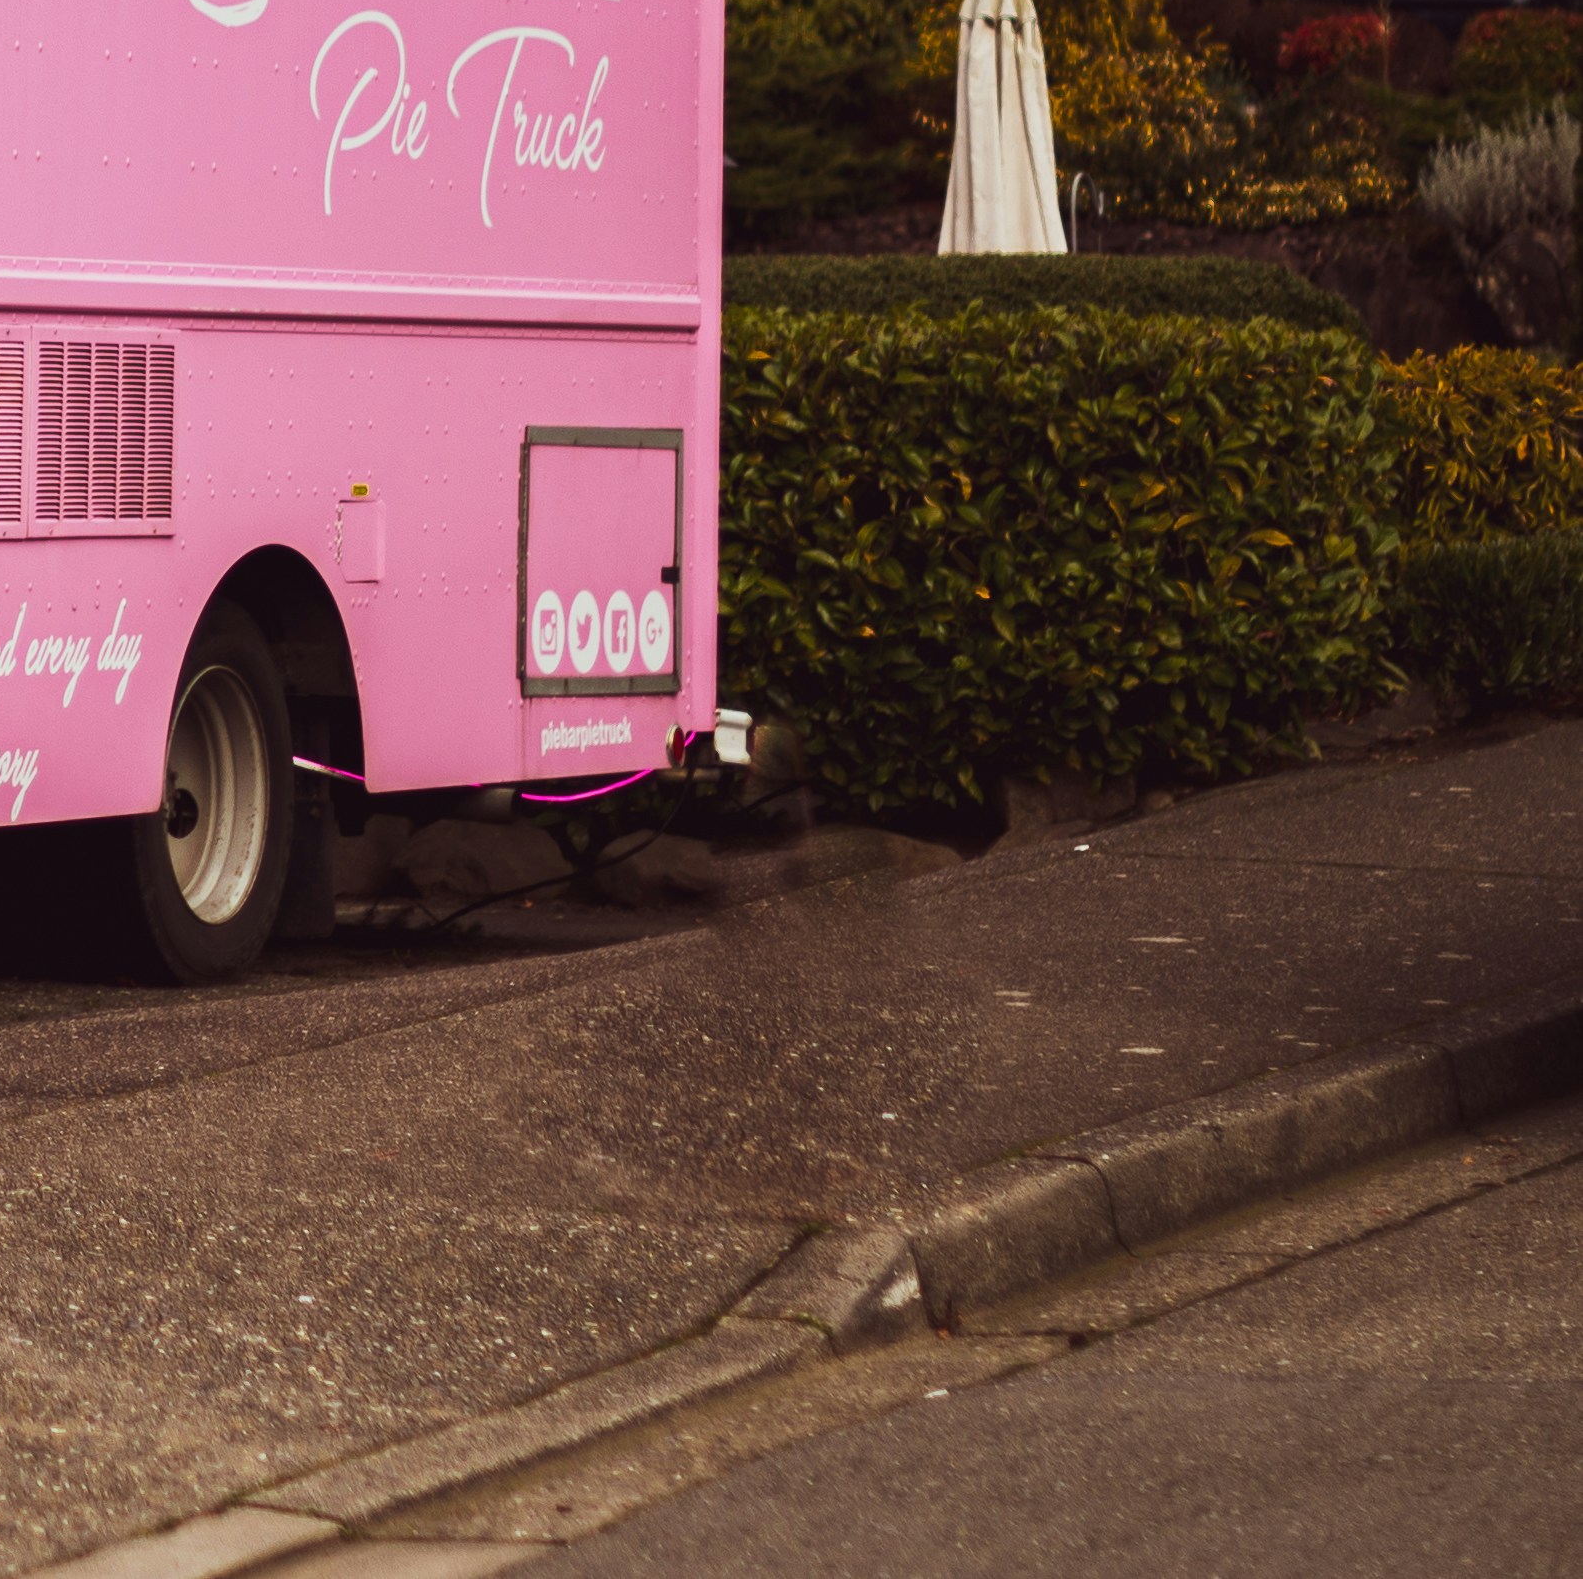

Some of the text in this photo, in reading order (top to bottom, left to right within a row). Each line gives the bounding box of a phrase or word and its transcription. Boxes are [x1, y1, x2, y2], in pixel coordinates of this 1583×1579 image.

[309, 10, 611, 229] Pie Truck
[23, 635, 92, 709] every
[97, 598, 143, 705] day
[541, 715, 632, 757] piebarpietruck
